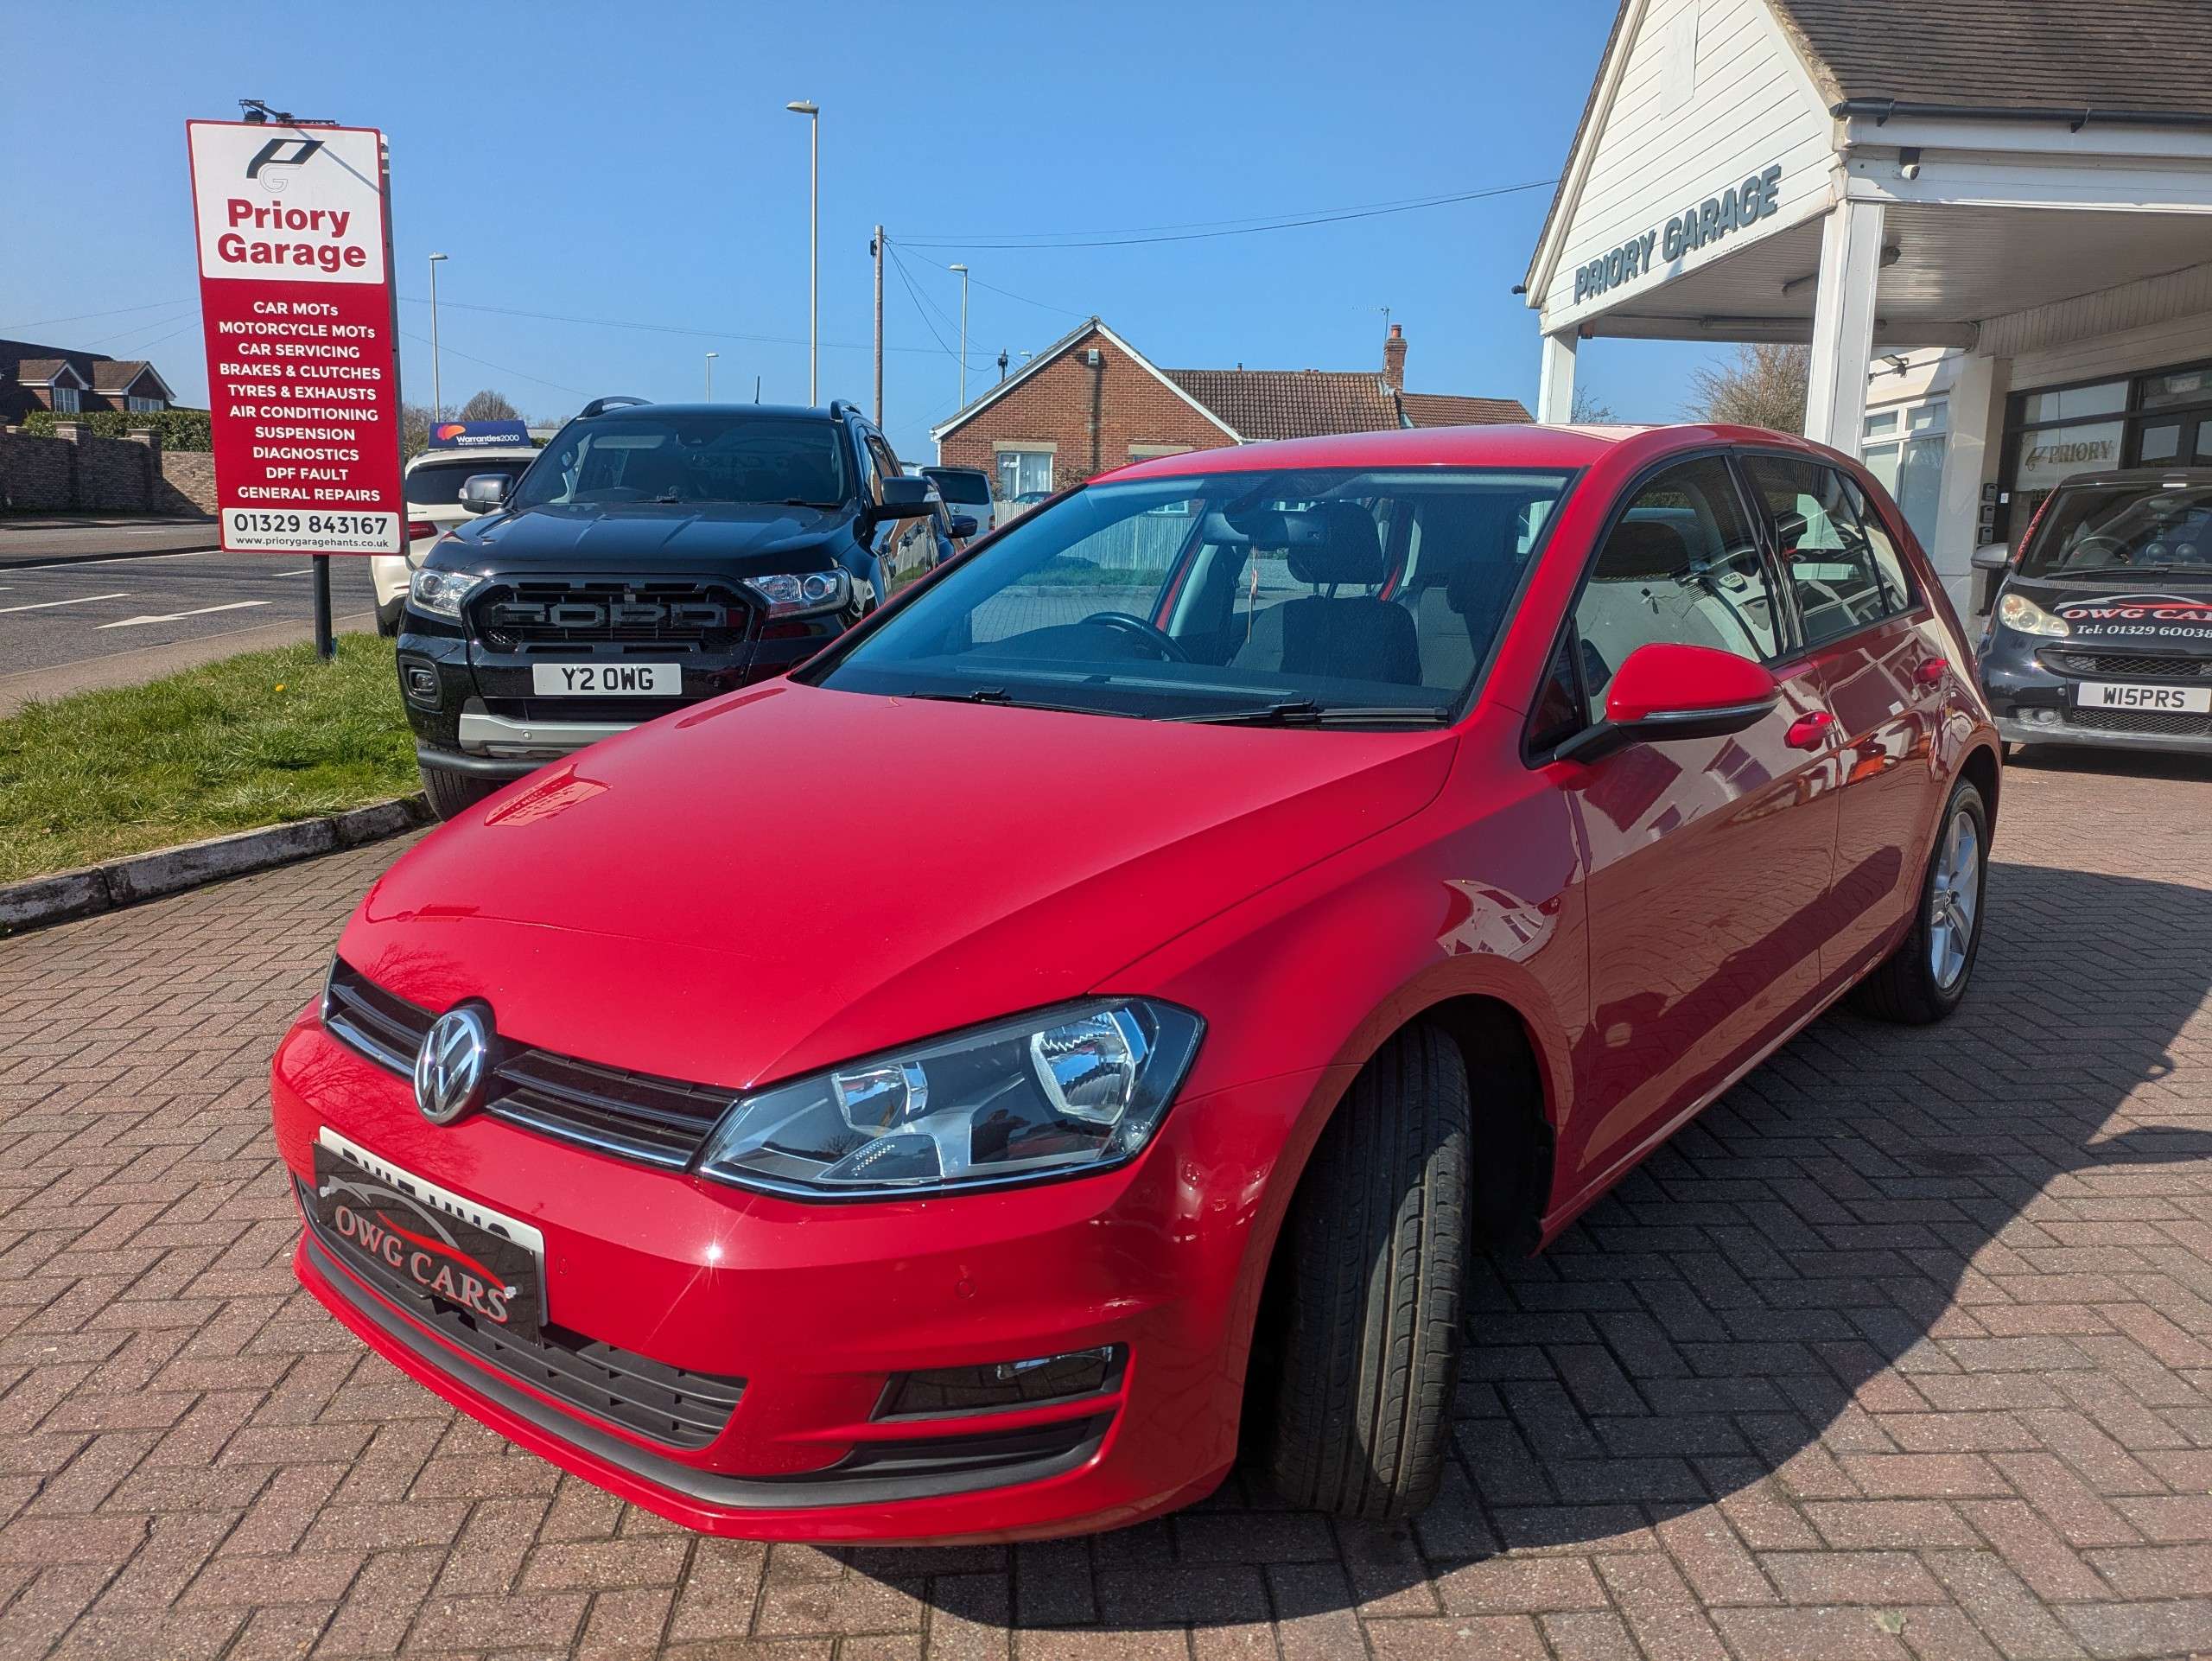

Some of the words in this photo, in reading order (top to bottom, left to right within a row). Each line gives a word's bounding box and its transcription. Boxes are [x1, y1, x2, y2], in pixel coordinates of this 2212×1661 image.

[227, 198, 350, 238] Priory
[1573, 229, 1657, 305] PRIORY
[1662, 163, 1782, 264] GARAGE
[217, 233, 366, 273] Garage
[253, 302, 288, 315] CAR
[293, 303, 339, 316] MOTs
[219, 321, 327, 337] MOTORCYCLE
[332, 325, 376, 339] MOTs
[238, 343, 271, 356] CAR
[275, 344, 360, 359] SERVICING
[219, 363, 281, 377] BRAKES
[285, 365, 296, 378] &
[300, 366, 381, 380] CLUTCHES
[227, 385, 276, 398] TYRES
[280, 385, 290, 398] &
[295, 386, 377, 401] EXHAUSTS
[230, 405, 257, 418] AIR
[260, 405, 378, 422] CONDITIONING
[255, 426, 355, 441] SUSPENSION
[456, 434, 519, 442] Warranties2000
[252, 447, 359, 461] DIAGNOSTICS
[2048, 440, 2113, 464] PRIORY
[265, 467, 296, 480] DPF
[300, 468, 349, 480] FAULT
[238, 486, 310, 500] GENERAL
[314, 488, 381, 502] REPAIRS
[234, 513, 301, 532] 01329
[308, 515, 387, 535] 843167
[235, 536, 389, 548] www.priorygaragehants.co.uk
[2062, 608, 2145, 620] OWG
[2075, 624, 2103, 634] Tel:
[2107, 625, 2156, 635] 01329
[562, 667, 595, 690] Y2
[602, 667, 654, 690] OWG
[334, 1206, 404, 1268] OWG
[410, 1251, 508, 1323] CARS
